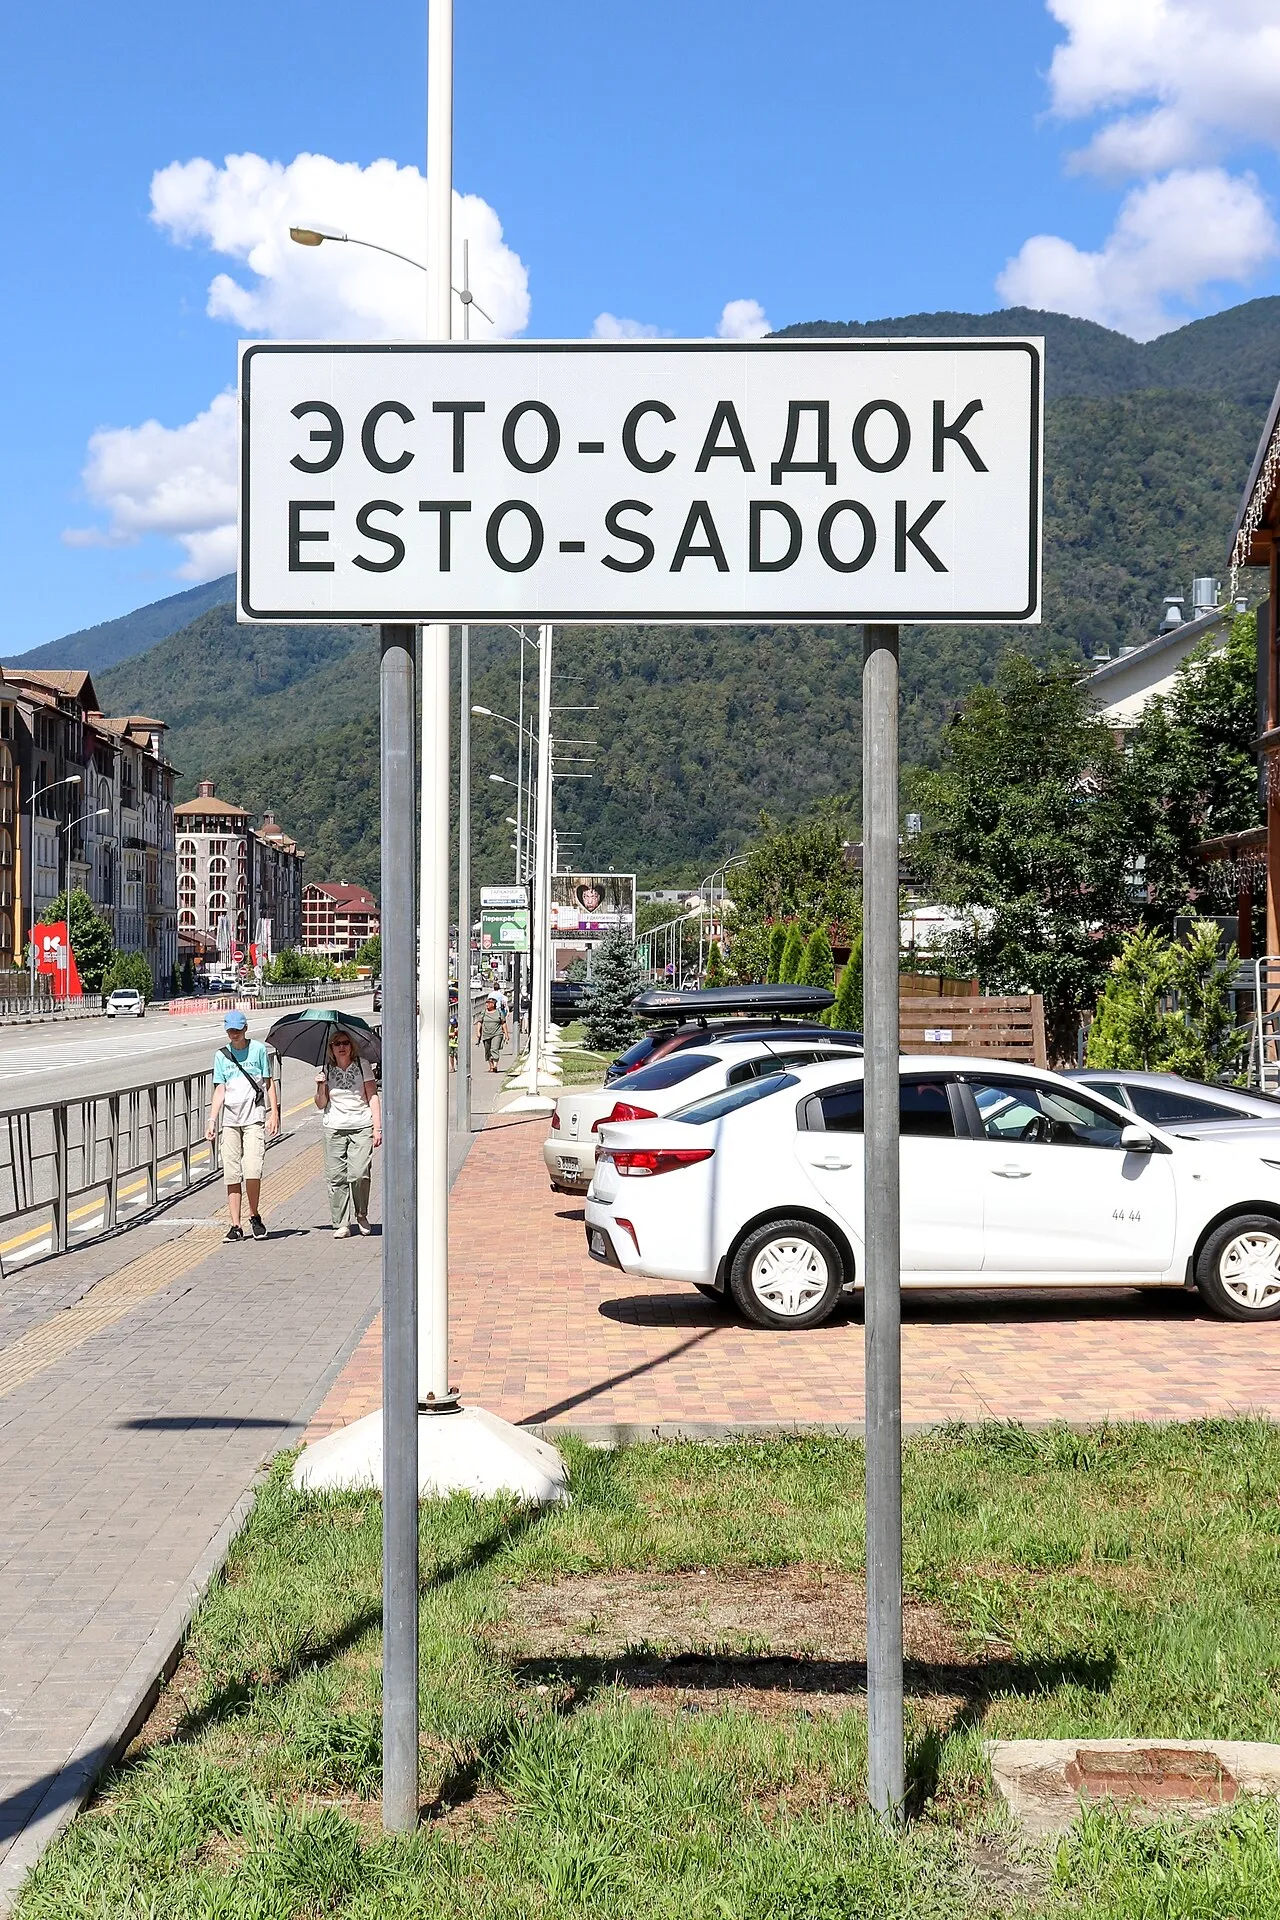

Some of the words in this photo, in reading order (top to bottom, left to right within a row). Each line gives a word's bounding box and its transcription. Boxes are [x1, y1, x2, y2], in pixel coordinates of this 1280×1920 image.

[290, 399, 989, 485] ЭСТО-САДОК
[289, 500, 949, 573] ESTO-SADOK
[1112, 1208, 1124, 1221] 44
[1129, 1209, 1141, 1222] 44
